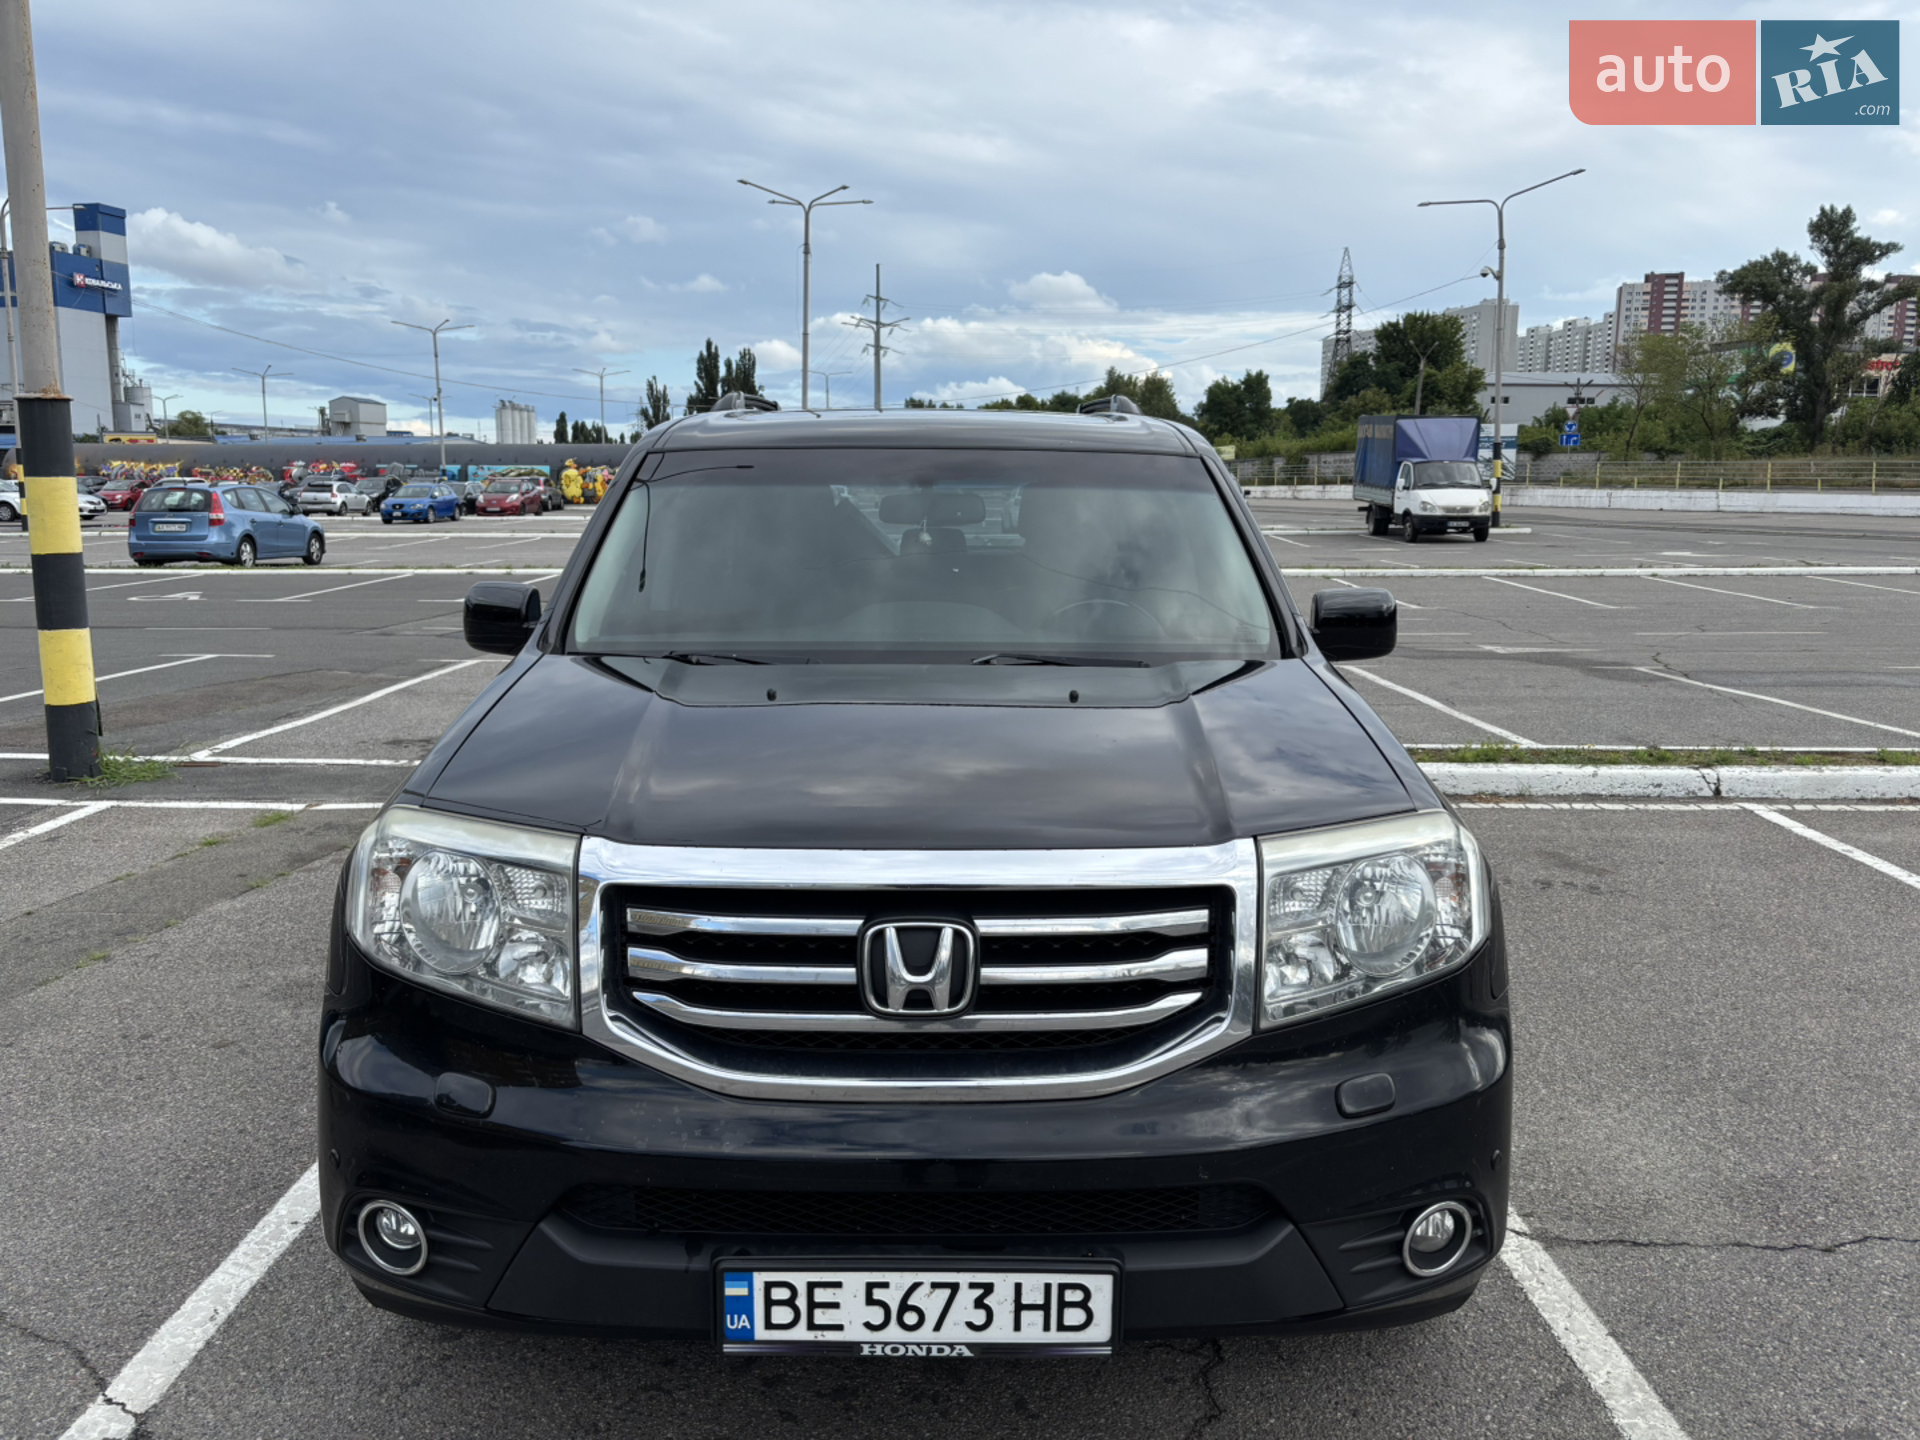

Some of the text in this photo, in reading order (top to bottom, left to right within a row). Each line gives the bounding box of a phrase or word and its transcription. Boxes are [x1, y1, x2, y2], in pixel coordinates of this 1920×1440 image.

[763, 1280, 1094, 1332] BE 5673 HB
[726, 1314, 751, 1330] UA
[860, 1343, 975, 1357] HONDA
